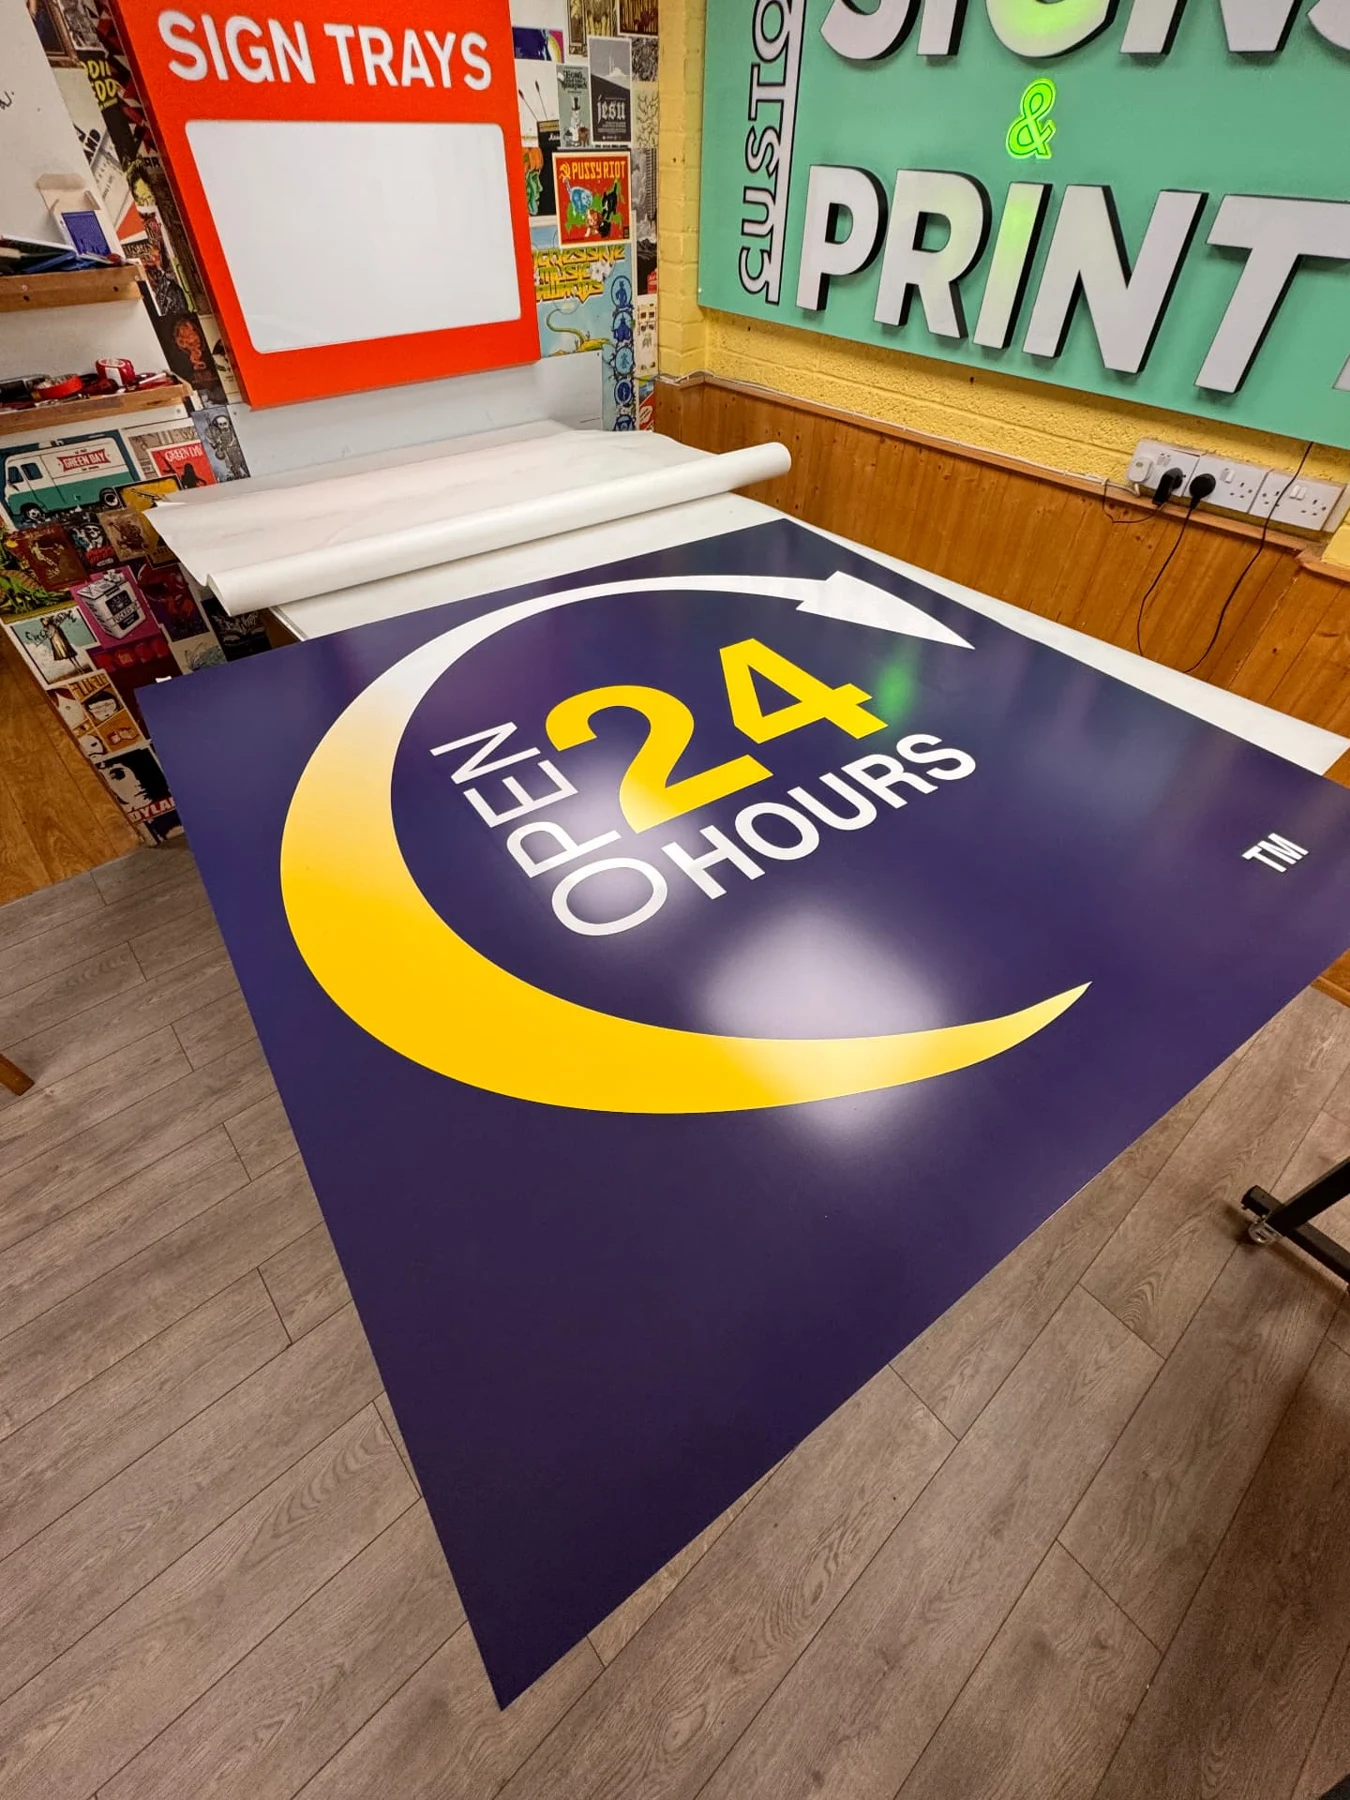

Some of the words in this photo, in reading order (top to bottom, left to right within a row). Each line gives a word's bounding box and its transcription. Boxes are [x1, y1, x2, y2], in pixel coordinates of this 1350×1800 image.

[158, 9, 316, 84] SIGN
[323, 22, 492, 91] TRAYS
[1005, 77, 1057, 160] &
[571, 162, 602, 180] PUSSY
[604, 160, 626, 179] RIOT
[796, 164, 1350, 396] PRINT
[63, 456, 90, 469] GREEN
[89, 451, 106, 464] DAY
[545, 638, 888, 834] 24
[430, 721, 669, 936] OPEN
[661, 733, 976, 899] HOURS
[1241, 832, 1309, 872] TM
